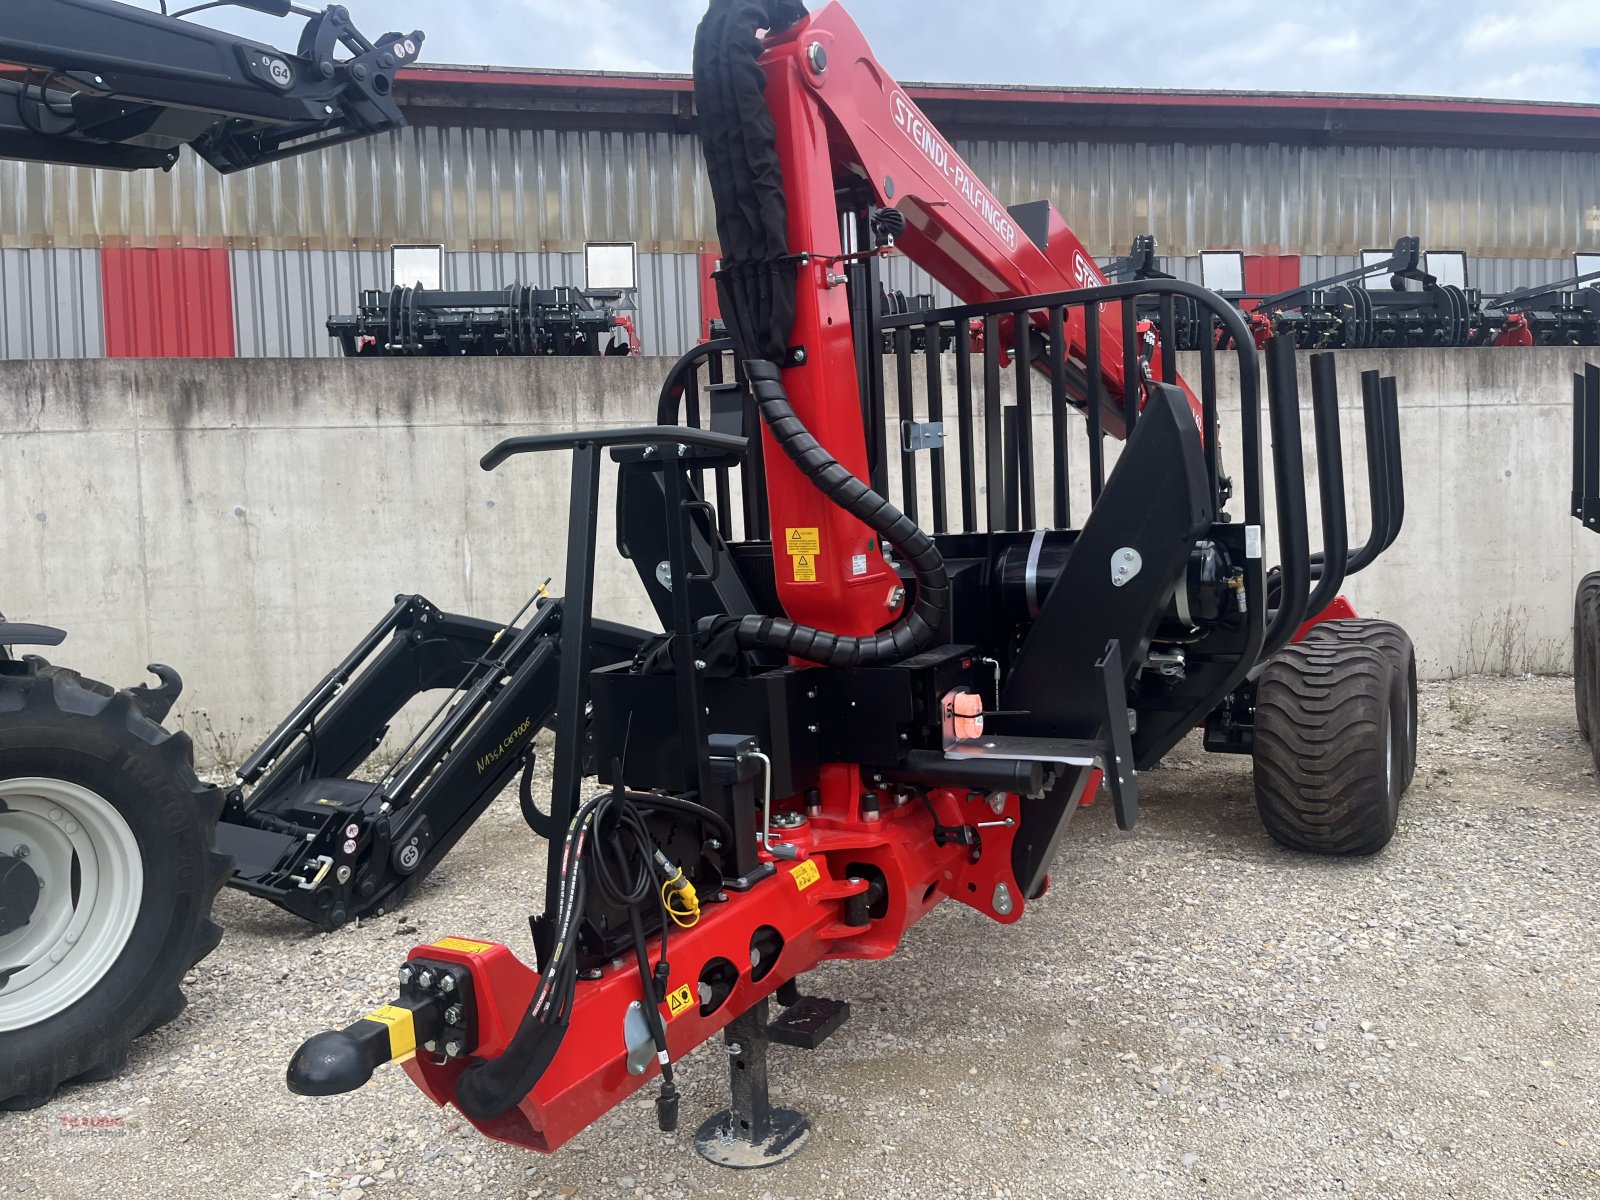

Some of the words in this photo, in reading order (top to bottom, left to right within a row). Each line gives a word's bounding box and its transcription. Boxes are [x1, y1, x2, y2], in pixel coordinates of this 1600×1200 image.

[272, 65, 289, 80] G4
[894, 97, 1016, 247] STEINDL-PALFINGER
[403, 847, 416, 864] G5
